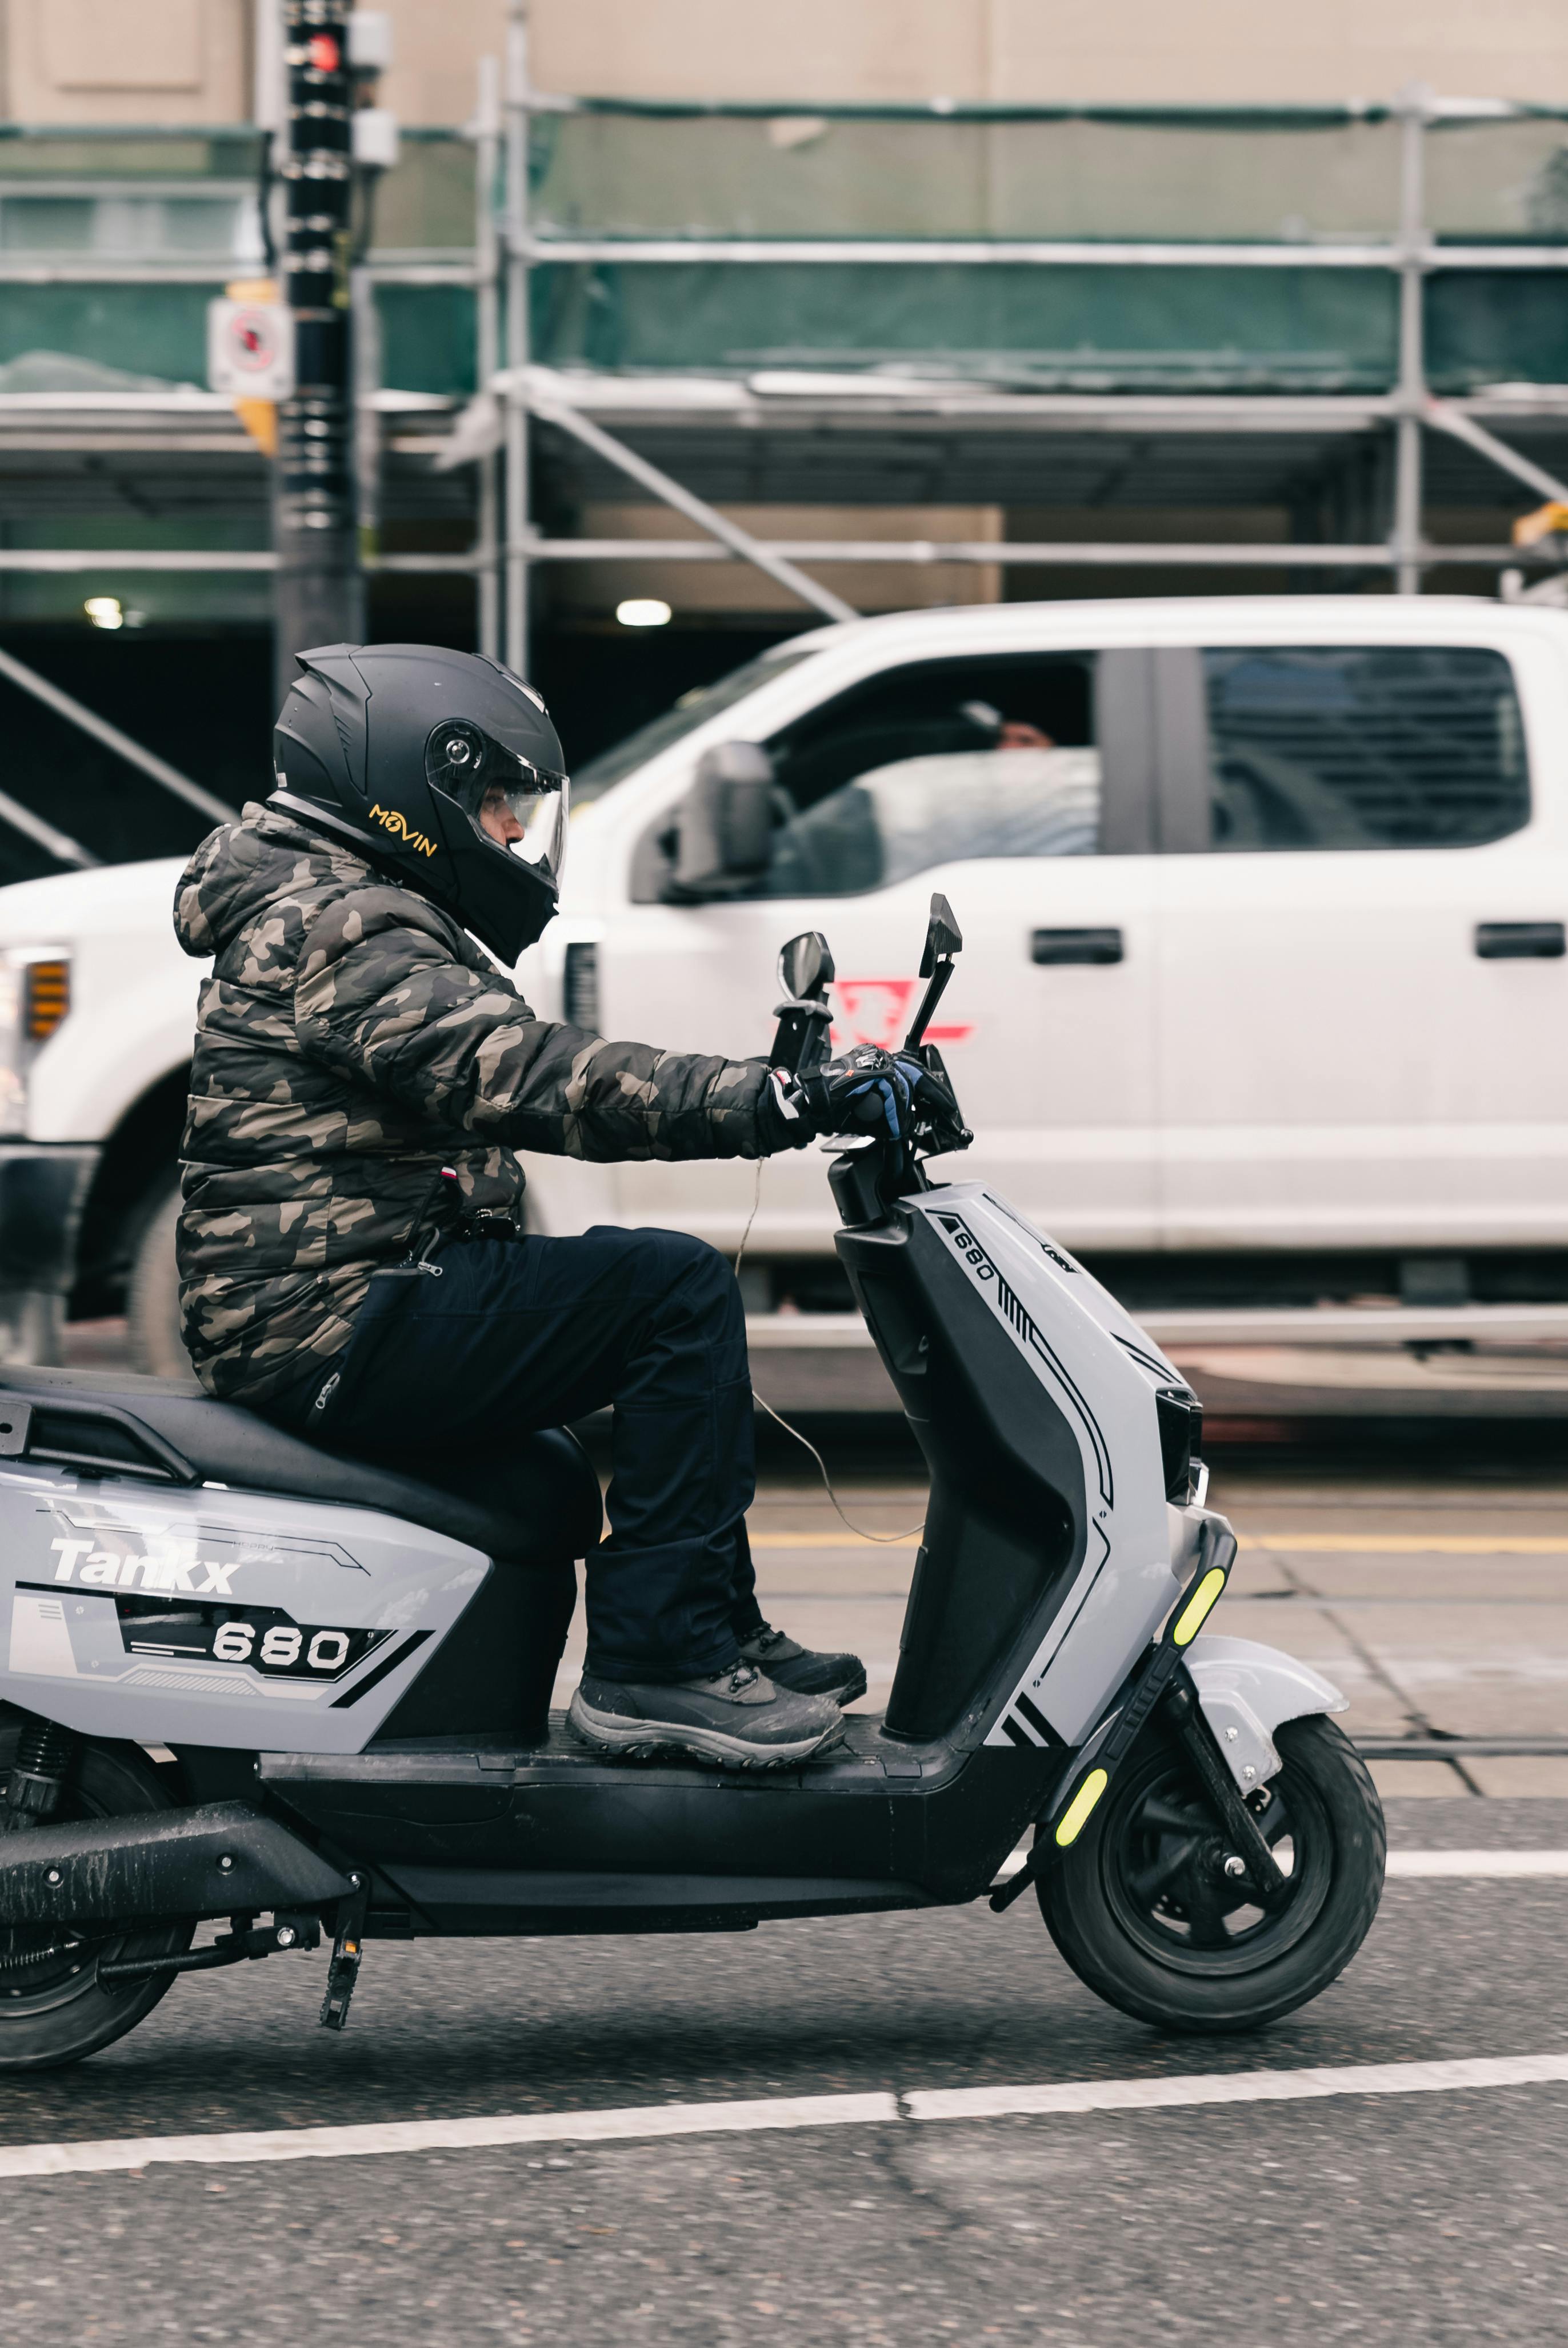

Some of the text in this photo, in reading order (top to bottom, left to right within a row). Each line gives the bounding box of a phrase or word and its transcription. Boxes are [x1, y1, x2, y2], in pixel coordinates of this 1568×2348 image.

[369, 804, 438, 857] MOVIN
[954, 1233, 995, 1281] 680
[50, 1537, 241, 1595] Tankx
[213, 1622, 350, 1670] 680
